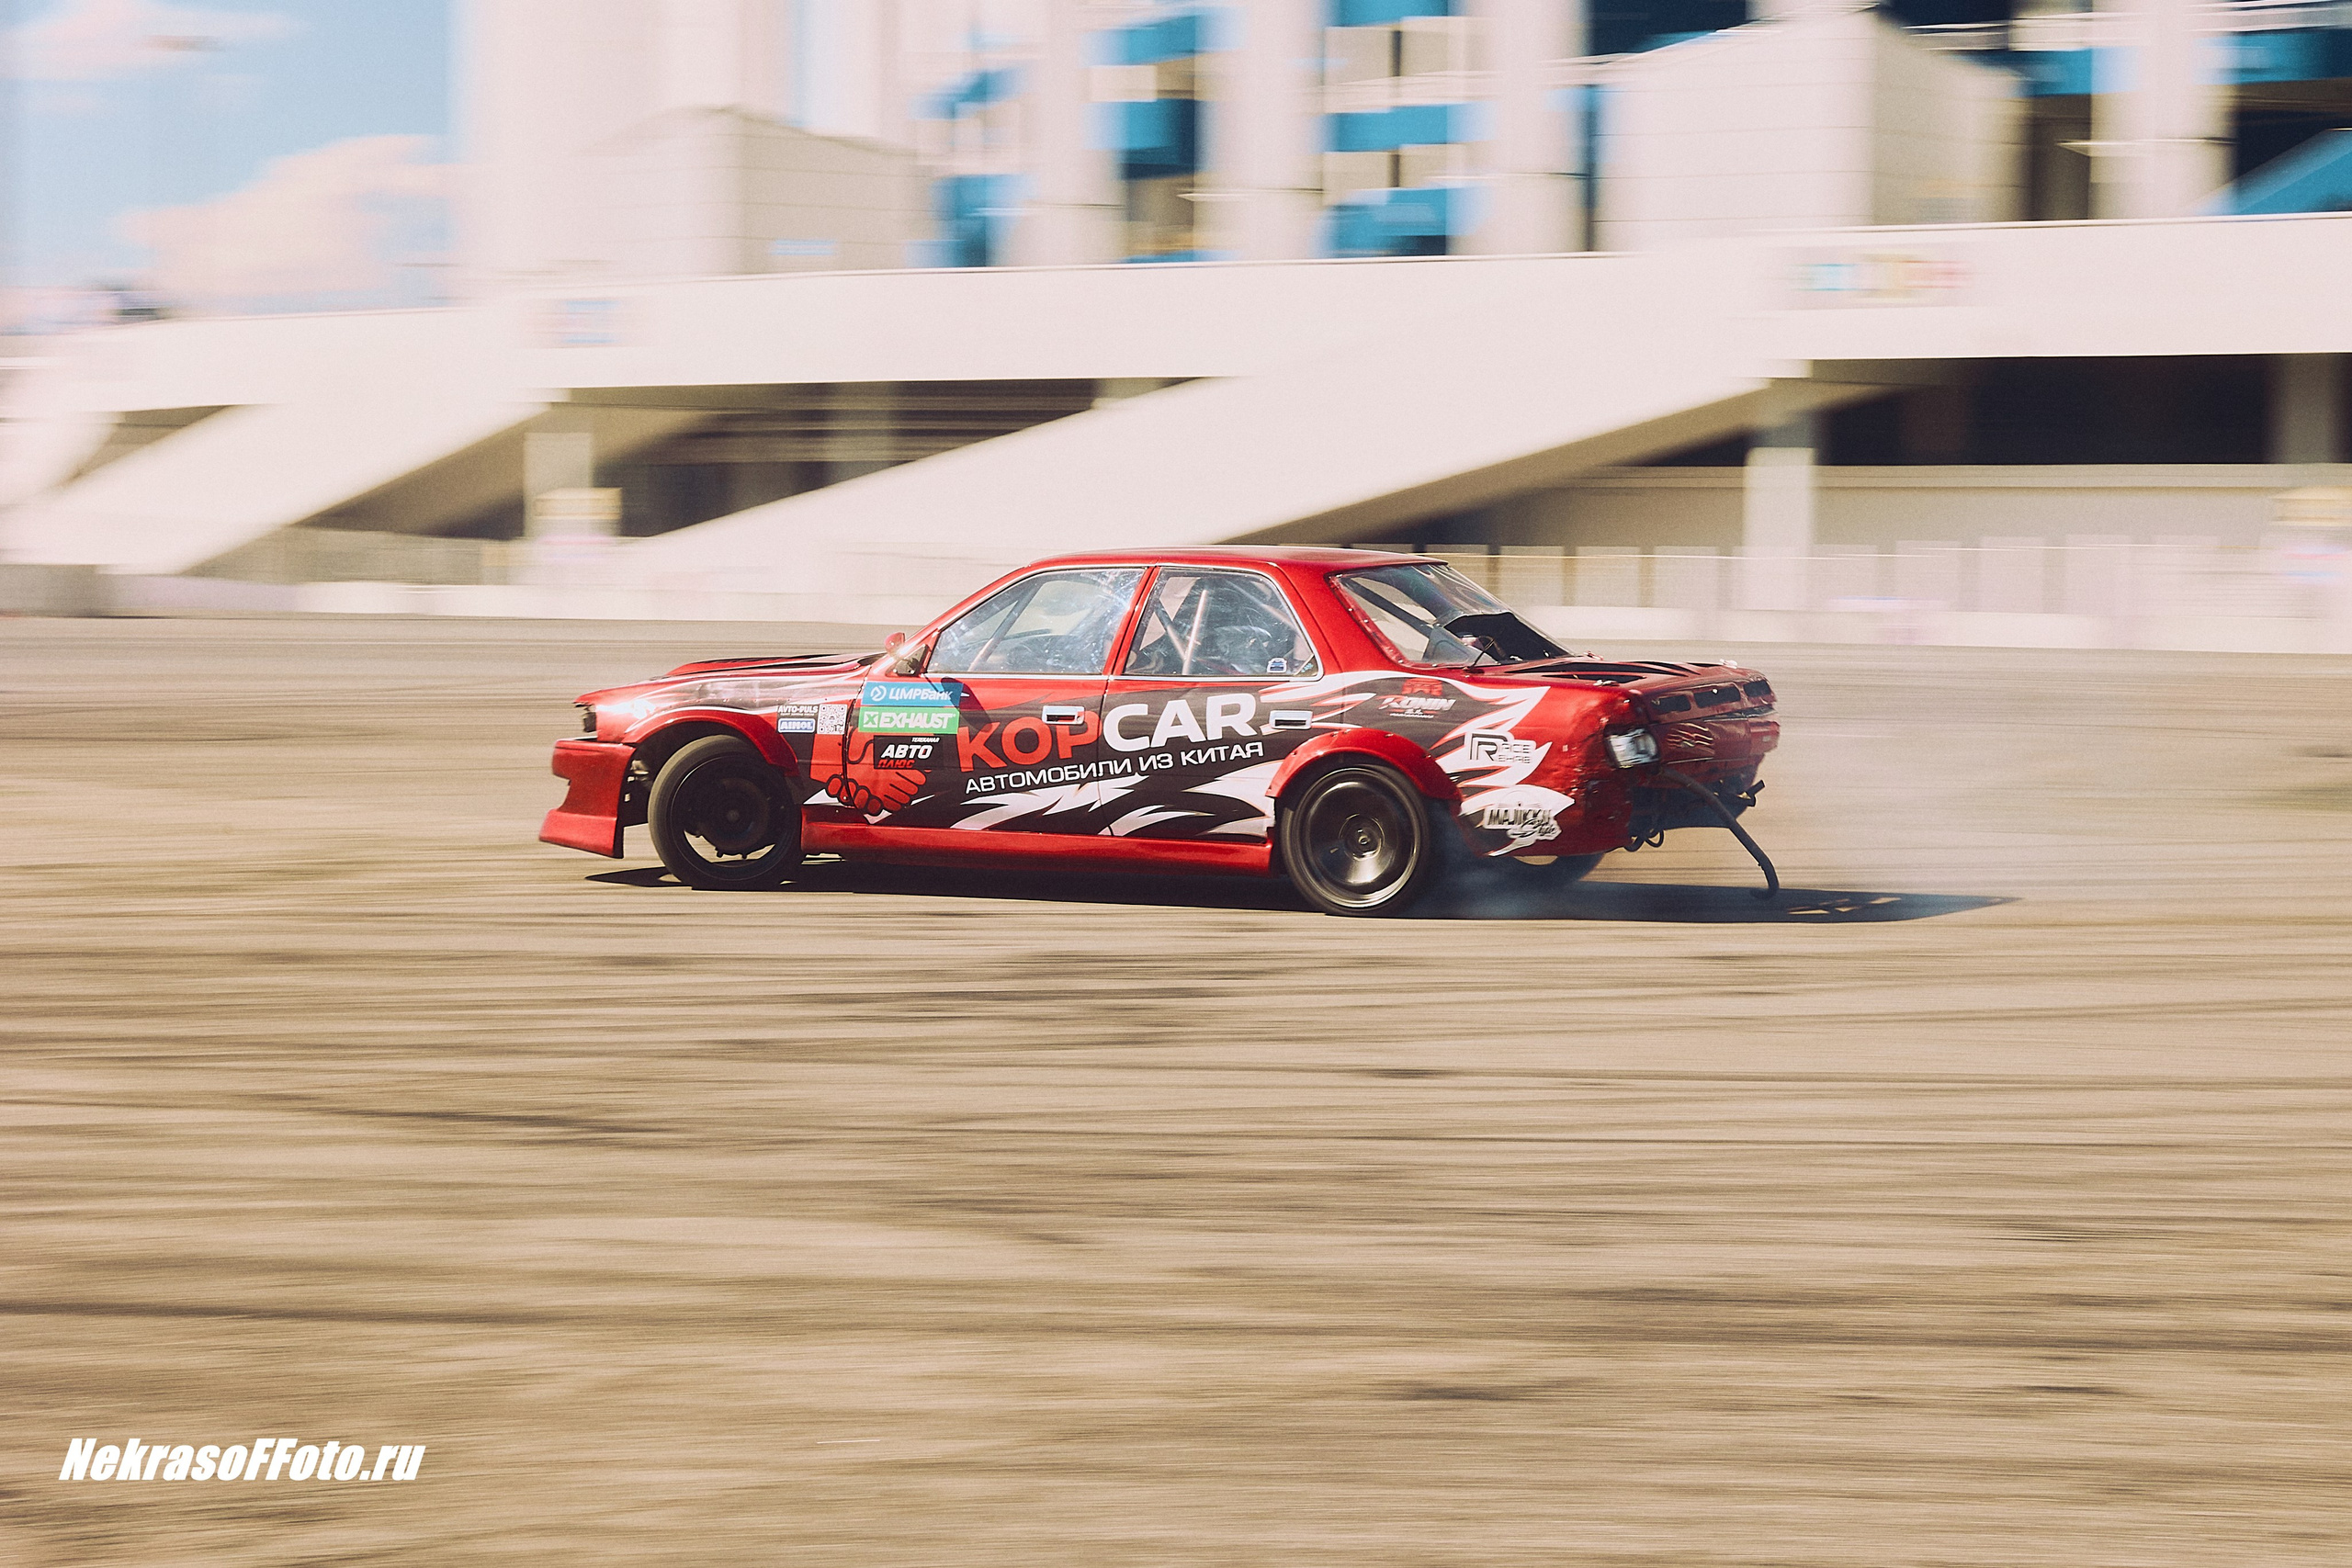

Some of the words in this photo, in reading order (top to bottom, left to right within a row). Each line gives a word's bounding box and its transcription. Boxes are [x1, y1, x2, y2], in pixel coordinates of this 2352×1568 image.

[888, 687, 953, 701] ЦМРБанк
[777, 705, 819, 714] AVTO-PULS
[881, 744, 933, 759] АВТО
[877, 759, 915, 769] ПЛЮС
[965, 758, 1131, 795] АВТОМОБИЛИ
[1140, 752, 1174, 773] ИЗ
[1181, 741, 1264, 766] КИТАЯ
